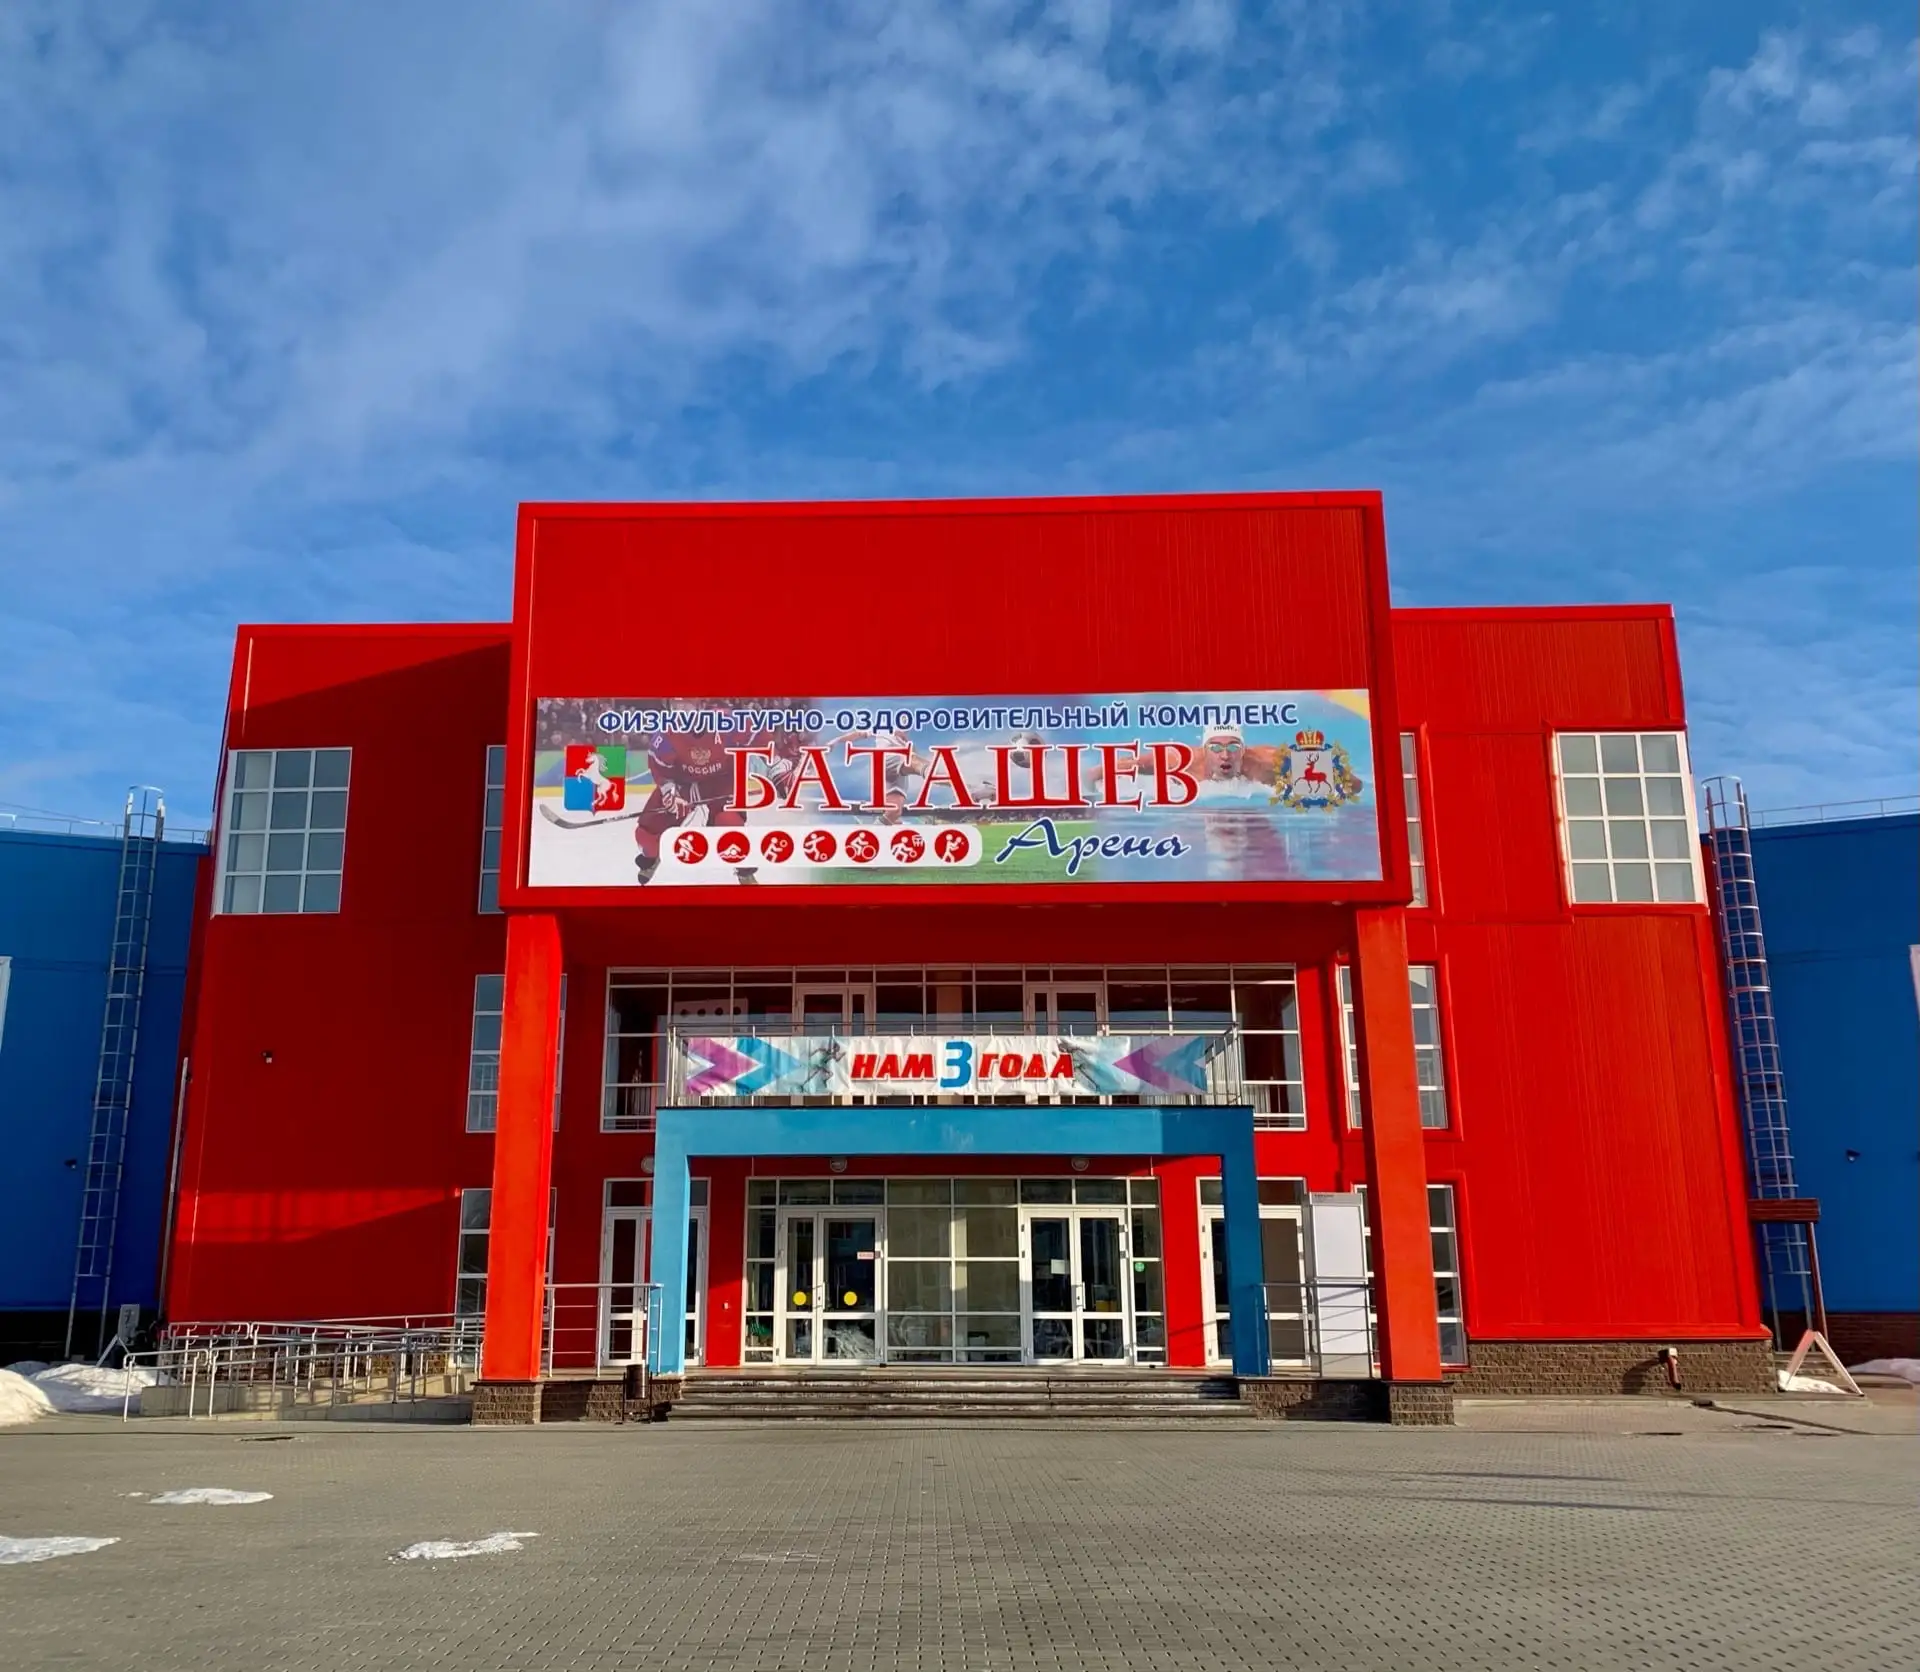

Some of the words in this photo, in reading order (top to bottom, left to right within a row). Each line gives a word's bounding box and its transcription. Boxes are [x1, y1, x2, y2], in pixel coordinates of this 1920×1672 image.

[599, 702, 1128, 732] ФИЗКУЛЬТУРНО-ОЗДОРОВИТЕЛЬНЫЙ
[1139, 703, 1298, 729] КОМПЛЕКС
[724, 741, 1199, 811] БАТАШЕВ
[996, 816, 1191, 876] Арена
[851, 1054, 935, 1081] НАМ
[940, 1040, 973, 1087] 3
[978, 1053, 1075, 1080] ГОДА
